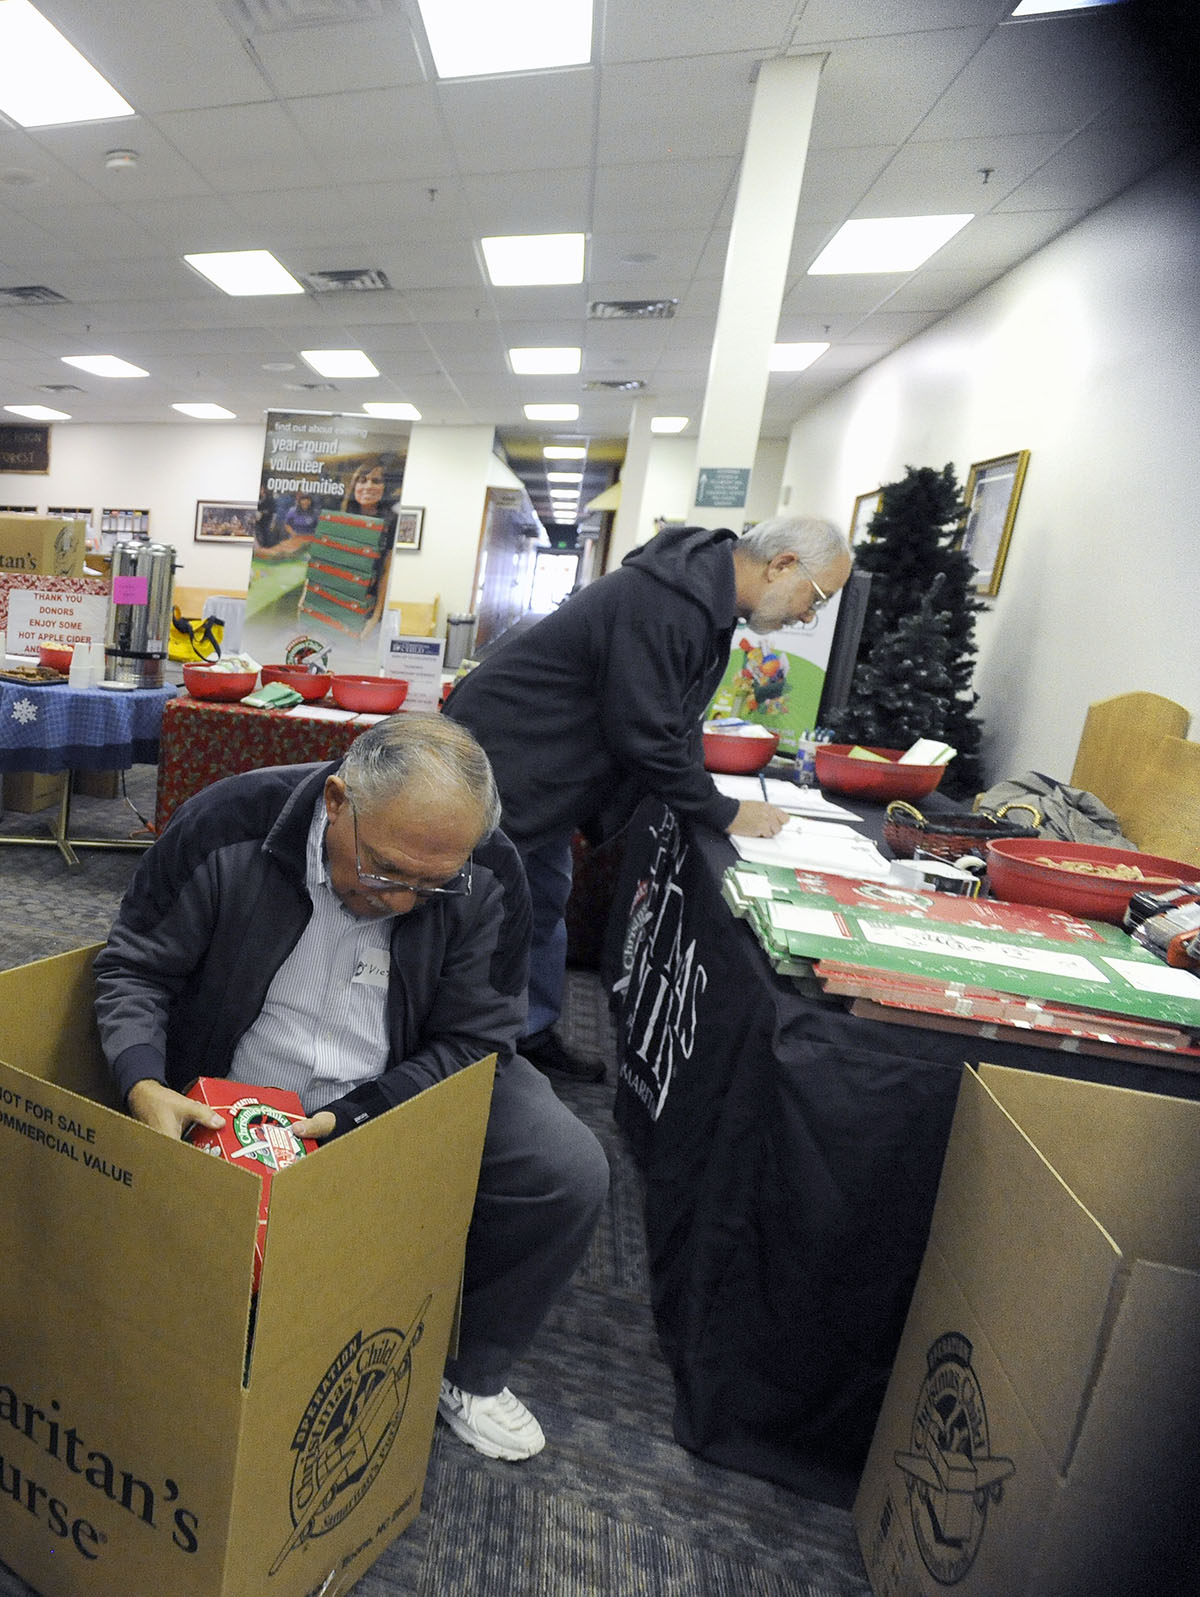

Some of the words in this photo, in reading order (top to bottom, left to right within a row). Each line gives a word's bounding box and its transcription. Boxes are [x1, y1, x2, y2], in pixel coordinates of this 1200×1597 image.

[292, 424, 307, 432] out
[308, 424, 333, 434] about
[271, 437, 338, 454] year-round
[270, 456, 325, 474] volunteer
[267, 477, 345, 496] opportunities
[33, 592, 63, 602] THANK
[65, 595, 83, 603] YOU
[39, 606, 74, 616] DONORS
[29, 619, 57, 628] ENJOY
[58, 622, 82, 630] SOME
[38, 633, 64, 642] APPLE
[66, 635, 91, 644] CIDER
[25, 1099, 54, 1126] FOR
[58, 1114, 97, 1145] SALE
[82, 1151, 134, 1187] VALUE
[355, 1339, 398, 1374] Child
[295, 1337, 360, 1443] OPERATION
[296, 1369, 353, 1510] Christmas
